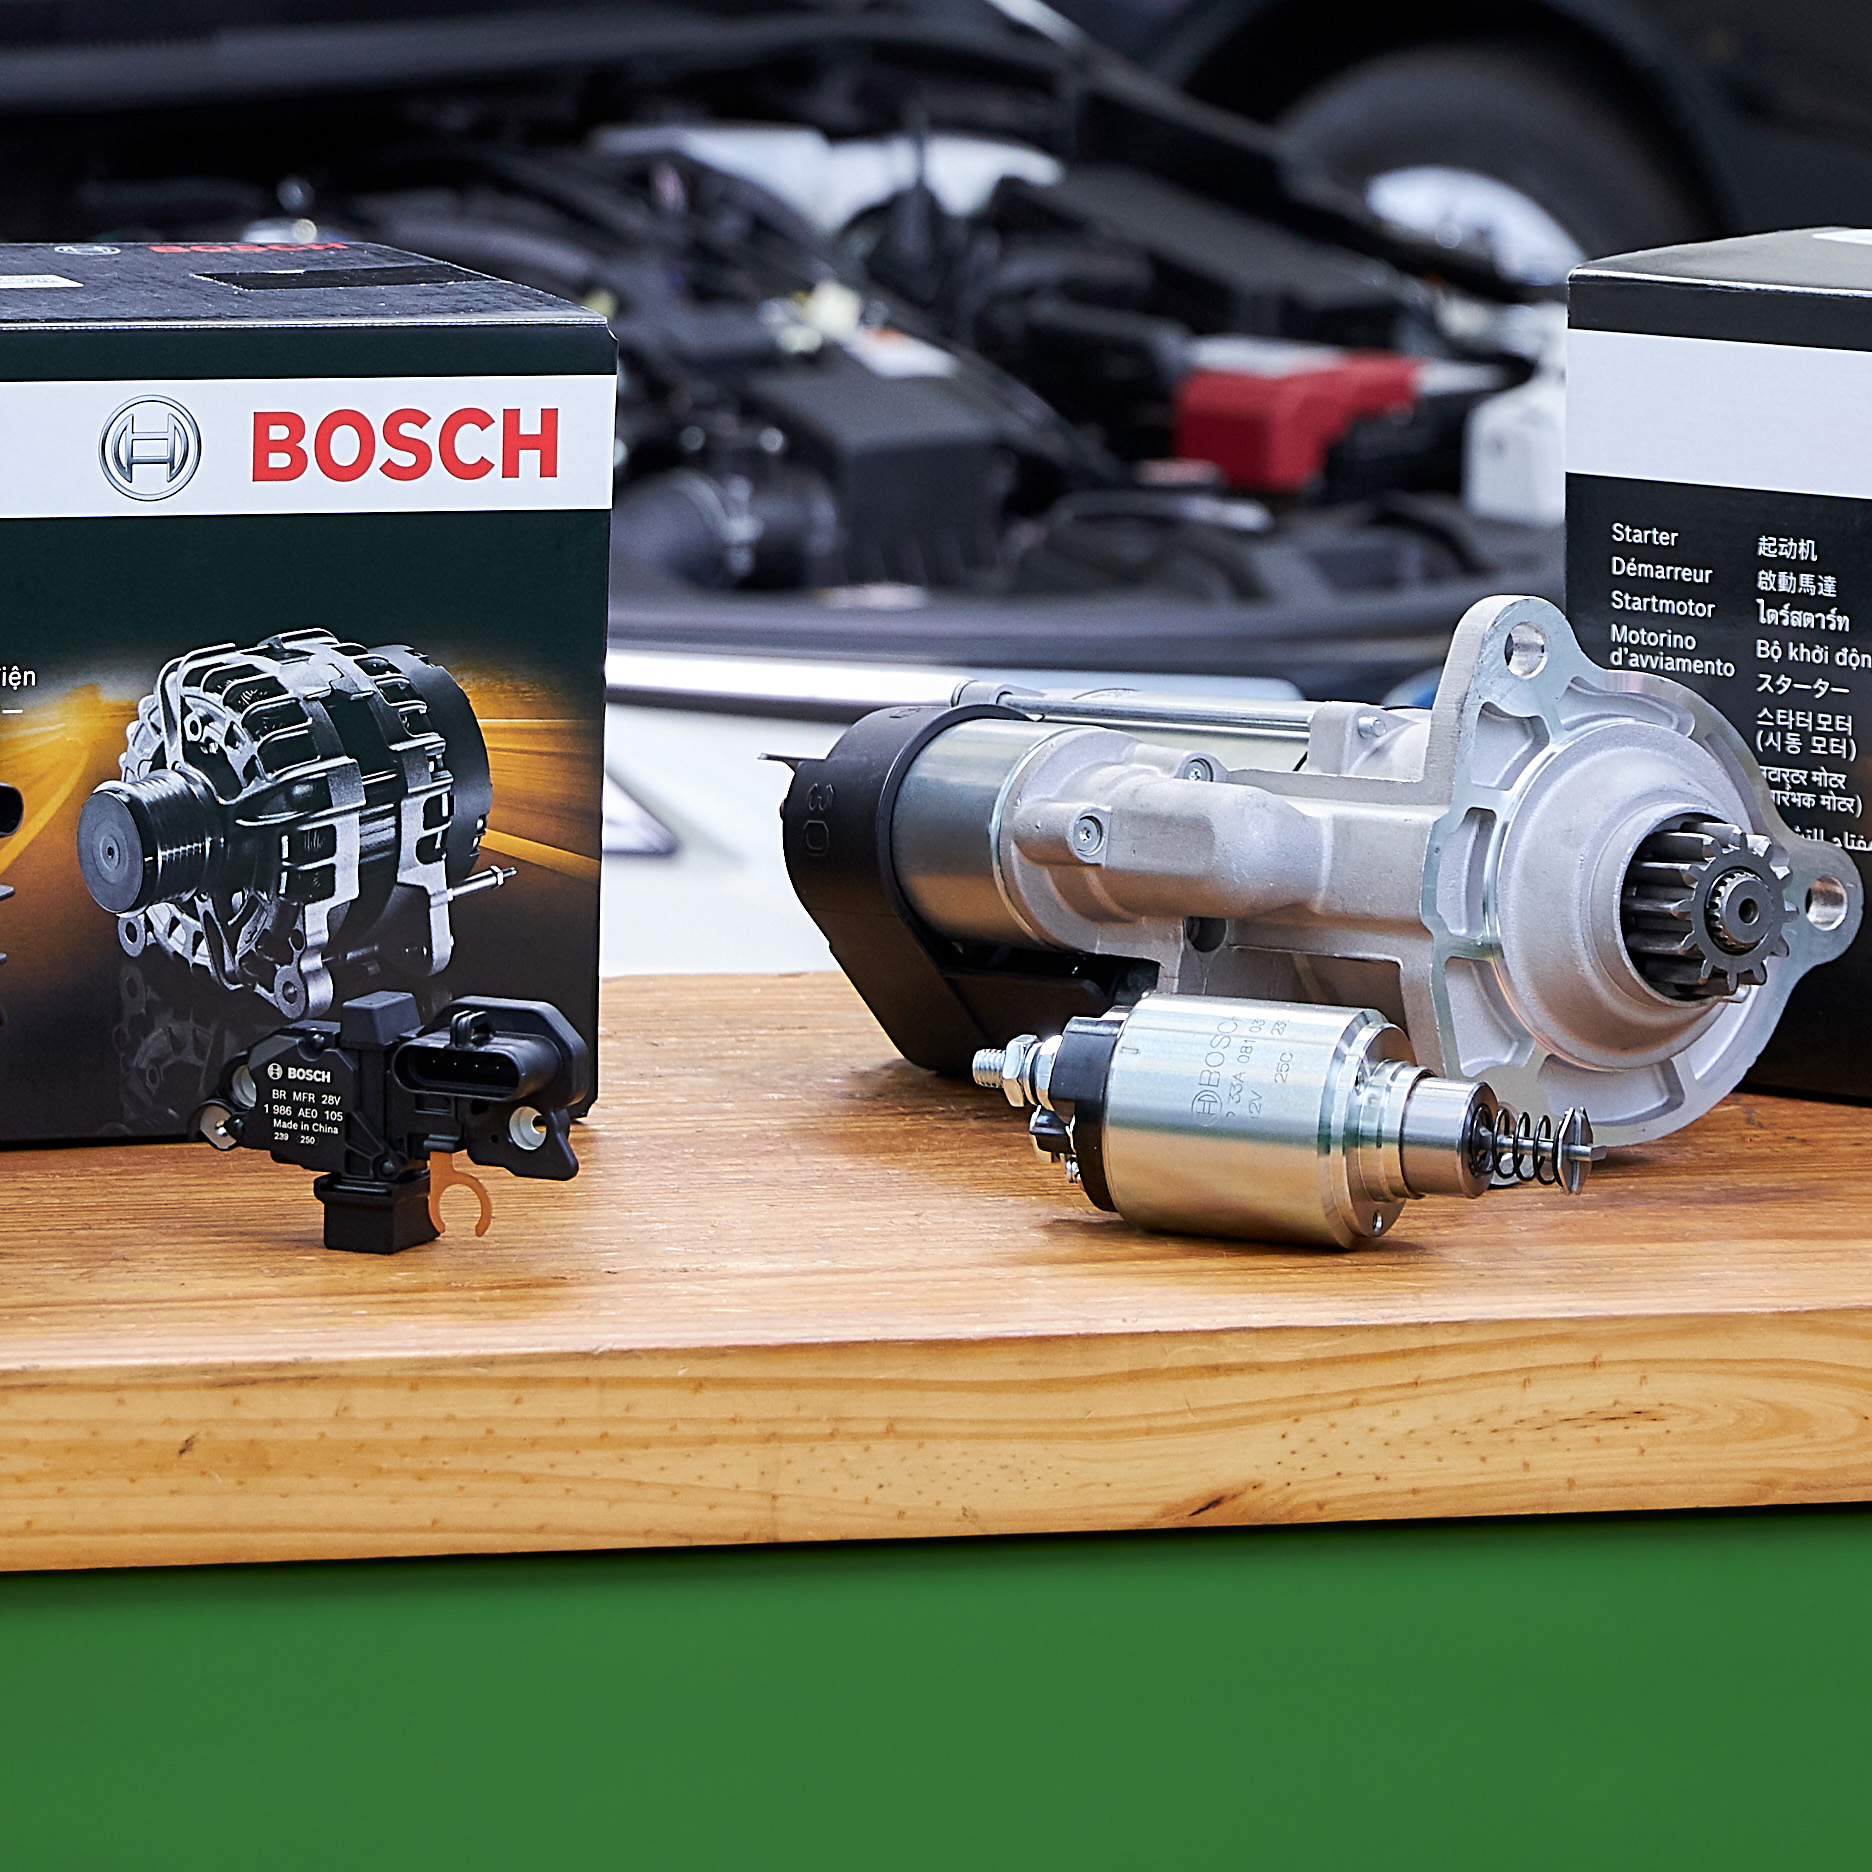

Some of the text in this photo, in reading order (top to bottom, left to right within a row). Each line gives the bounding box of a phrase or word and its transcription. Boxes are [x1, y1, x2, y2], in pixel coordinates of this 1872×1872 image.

[253, 407, 559, 483] BOSCH
[1611, 522, 1679, 547] Starter
[1756, 535, 1818, 561] 起动机
[1611, 556, 1713, 584] Démarreur
[1611, 590, 1716, 618] Startmotor
[1610, 623, 1697, 651] Motorino
[1609, 646, 1736, 678] d'avviamento
[1755, 639, 1783, 663] Bộ
[1756, 673, 1850, 698] スターター
[1755, 730, 1857, 762] (시동 모터)
[1811, 766, 1848, 790] मोटर
[1820, 790, 1863, 819] मोटर)
[1237, 1039, 1256, 1064] 081
[287, 1067, 331, 1083] BOSCH
[272, 1089, 341, 1105] BR MFR 28V
[264, 1104, 269, 1113] 1
[273, 1105, 292, 1116] 986
[324, 1111, 343, 1121] 105
[273, 1119, 339, 1134] Made in China
[274, 1132, 315, 1144] 239 250
